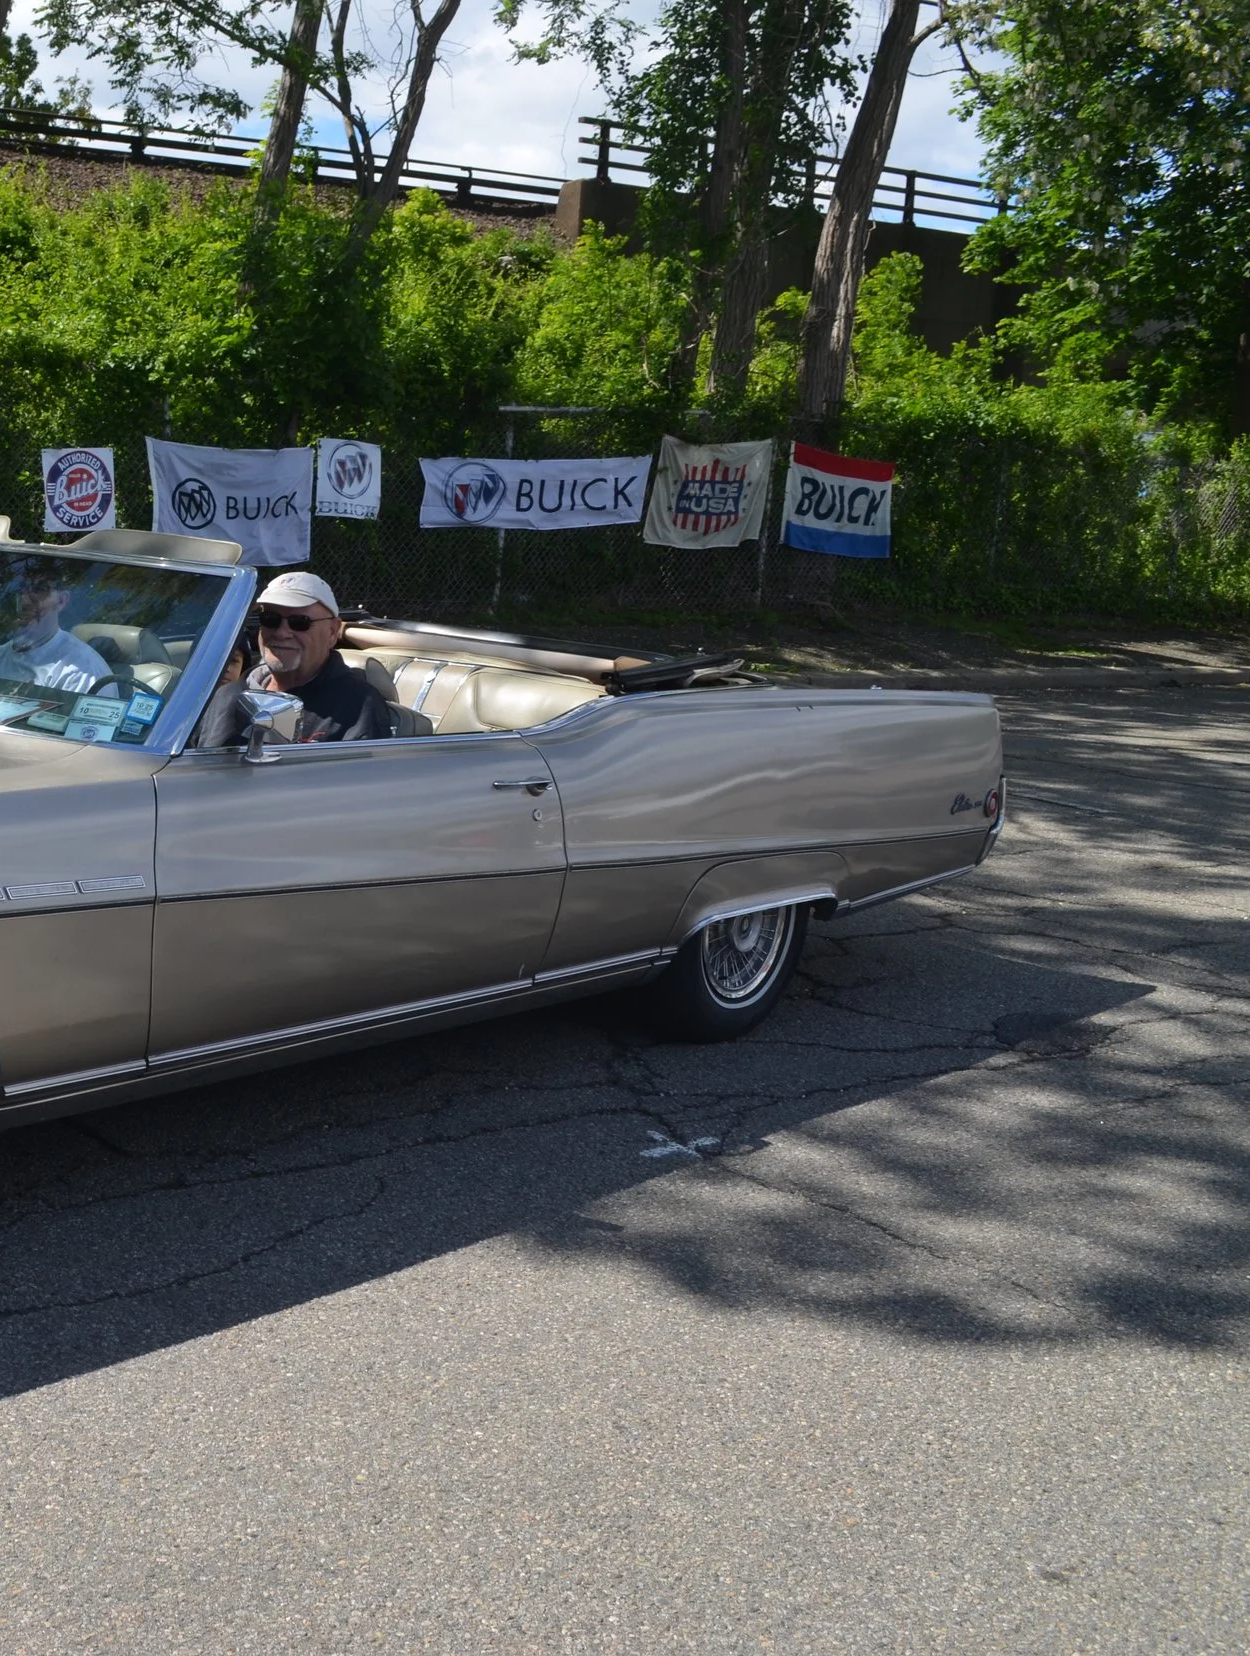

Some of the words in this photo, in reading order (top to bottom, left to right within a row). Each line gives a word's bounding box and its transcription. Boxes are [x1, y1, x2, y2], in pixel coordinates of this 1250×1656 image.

[57, 452, 101, 471] AUTHORIZED
[53, 470, 108, 506] Buick
[515, 475, 638, 513] BUICK
[683, 482, 739, 498] MADE
[226, 491, 298, 520] BUICK
[317, 500, 378, 518] BUICK
[679, 499, 690, 508] IN
[690, 497, 736, 513] USA
[795, 476, 887, 526] BUICK
[56, 506, 103, 527] SERVICE
[109, 711, 120, 719] 25
